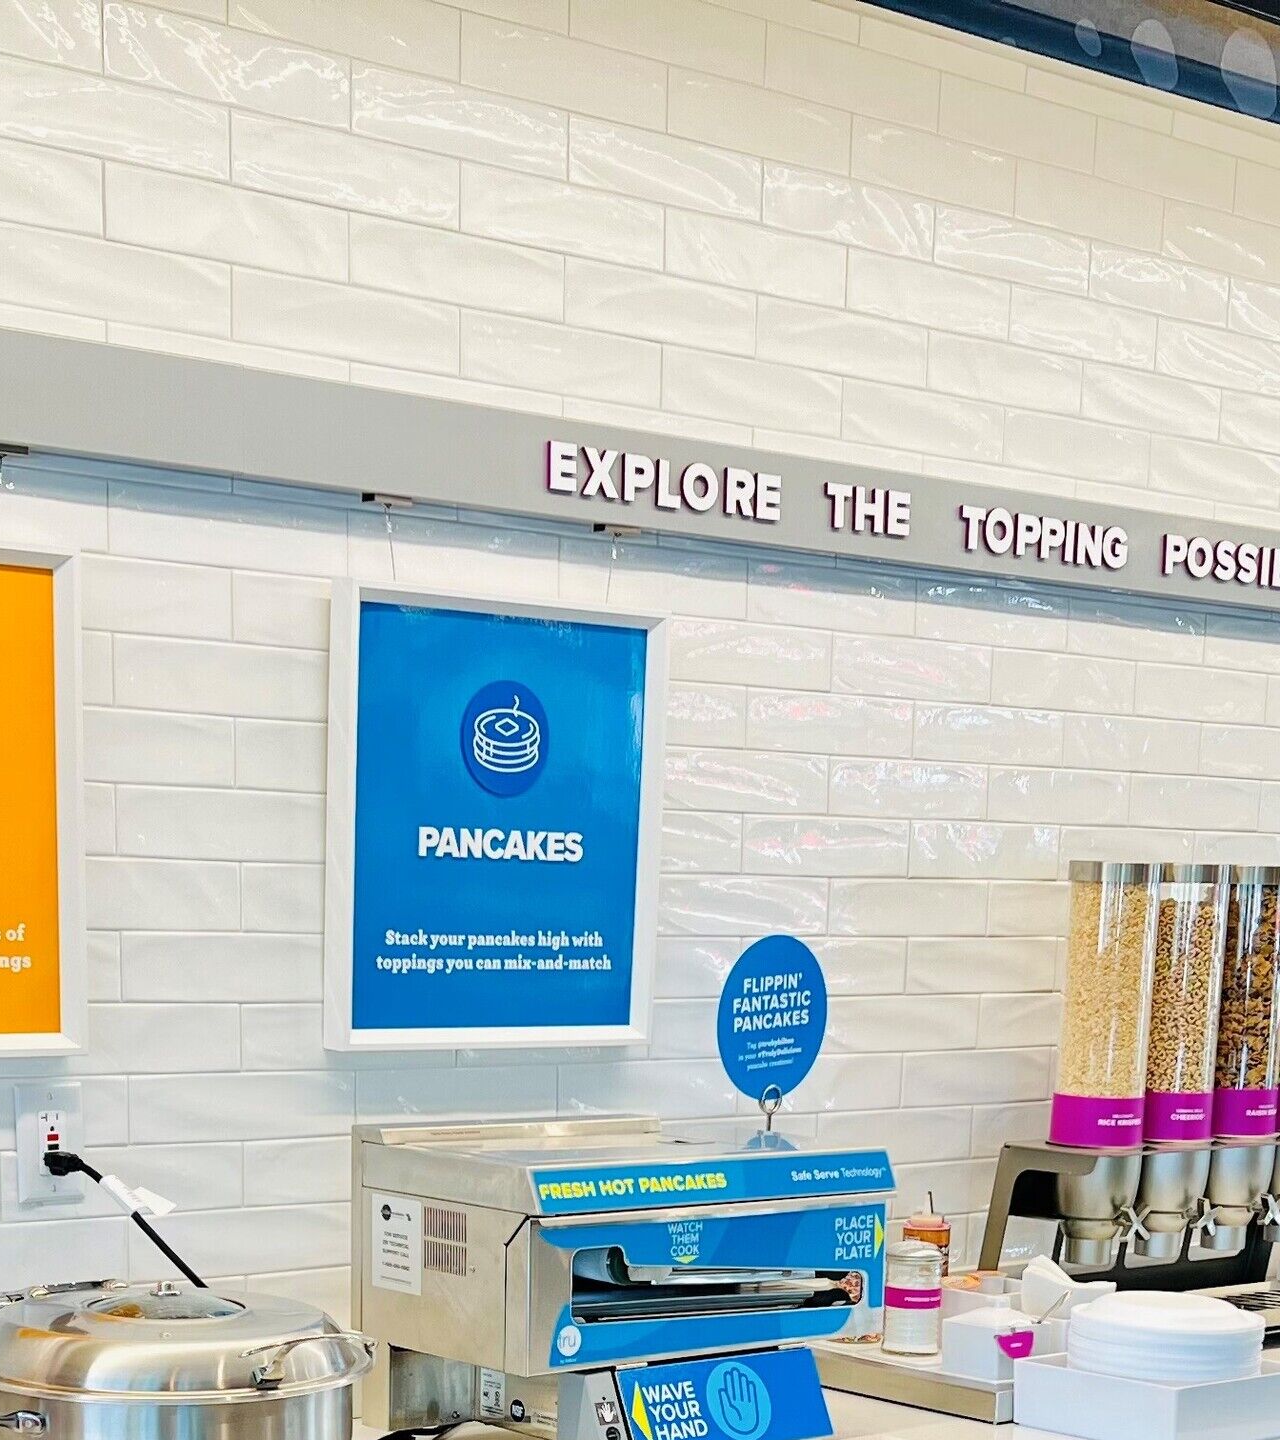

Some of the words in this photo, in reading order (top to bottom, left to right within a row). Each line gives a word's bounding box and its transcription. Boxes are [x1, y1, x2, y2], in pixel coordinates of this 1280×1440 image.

[546, 440, 782, 522] EXPLORE
[825, 482, 911, 538] THE
[959, 504, 1129, 570] TOPPING
[418, 826, 583, 862] PANCAKES
[6, 923, 26, 942] of
[385, 929, 429, 946] Stack
[429, 934, 465, 950] your
[467, 930, 535, 950] pancakes
[538, 930, 569, 950] high
[572, 930, 603, 947] with
[376, 953, 443, 974] toppings
[446, 958, 472, 974] you
[476, 958, 501, 970] can
[504, 954, 612, 970] mix-and-match
[743, 972, 802, 995] FLIPPIN'
[733, 990, 811, 1014] FANTASTIC
[733, 1009, 809, 1033] PANCAKES
[791, 1169, 812, 1181] Safe
[813, 1169, 840, 1180] Serve
[539, 1181, 597, 1200] FRESH
[599, 1178, 634, 1196] HOT
[638, 1172, 727, 1193] PANCAKES
[668, 1221, 703, 1234] WATCH
[835, 1215, 873, 1231] PLACE
[672, 1233, 700, 1245] THEM
[836, 1230, 871, 1245] YOUR
[670, 1244, 700, 1257] COOK
[835, 1245, 872, 1261] PLATE
[642, 1381, 695, 1404] WAVE
[649, 1401, 702, 1423] YOUR
